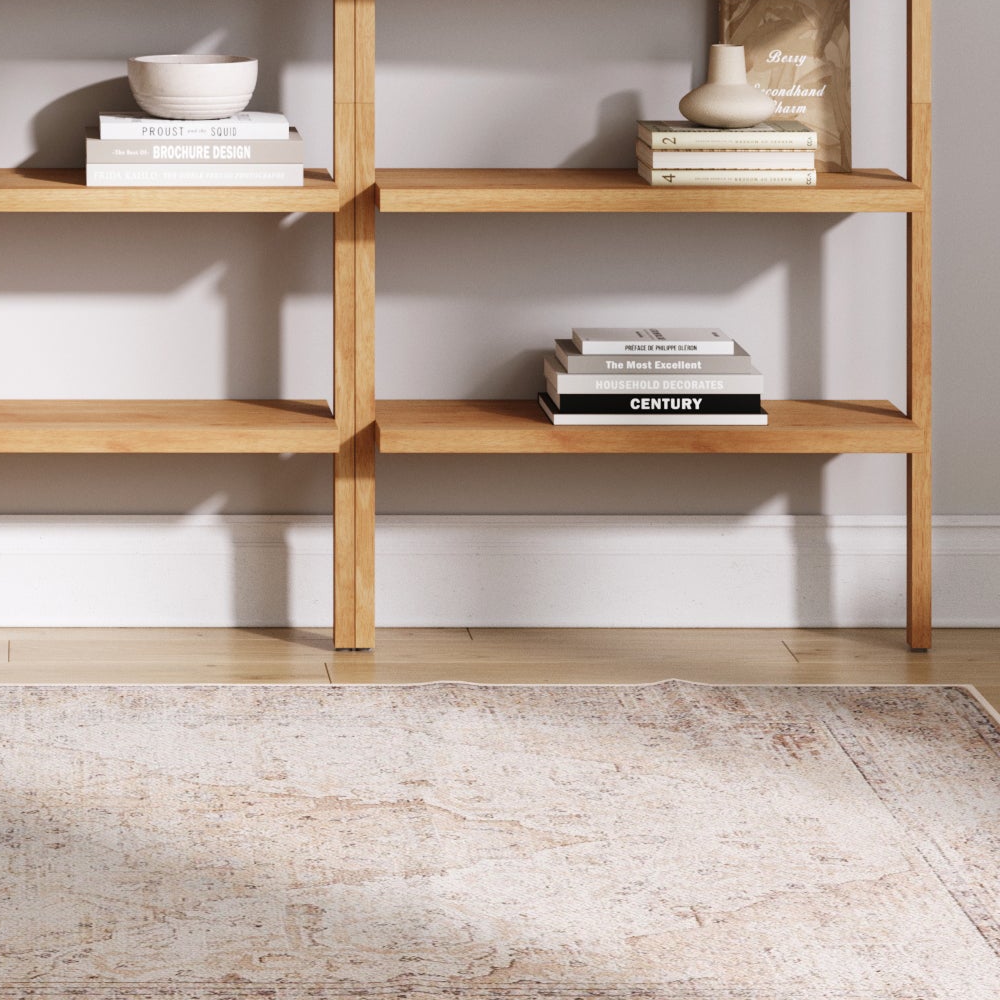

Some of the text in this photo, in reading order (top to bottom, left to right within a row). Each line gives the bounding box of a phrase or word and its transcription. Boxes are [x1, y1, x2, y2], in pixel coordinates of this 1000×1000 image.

[141, 126, 184, 137] PROUST
[210, 126, 237, 137] SQUID
[662, 137, 677, 145] 2
[152, 145, 210, 160] BROCHURE
[213, 145, 251, 160] DESIGN
[661, 173, 676, 183] 4
[605, 360, 702, 370] The Most Excellent
[595, 379, 724, 390] HOUSEHOLD DECORATES
[629, 398, 703, 410] CENTURY
